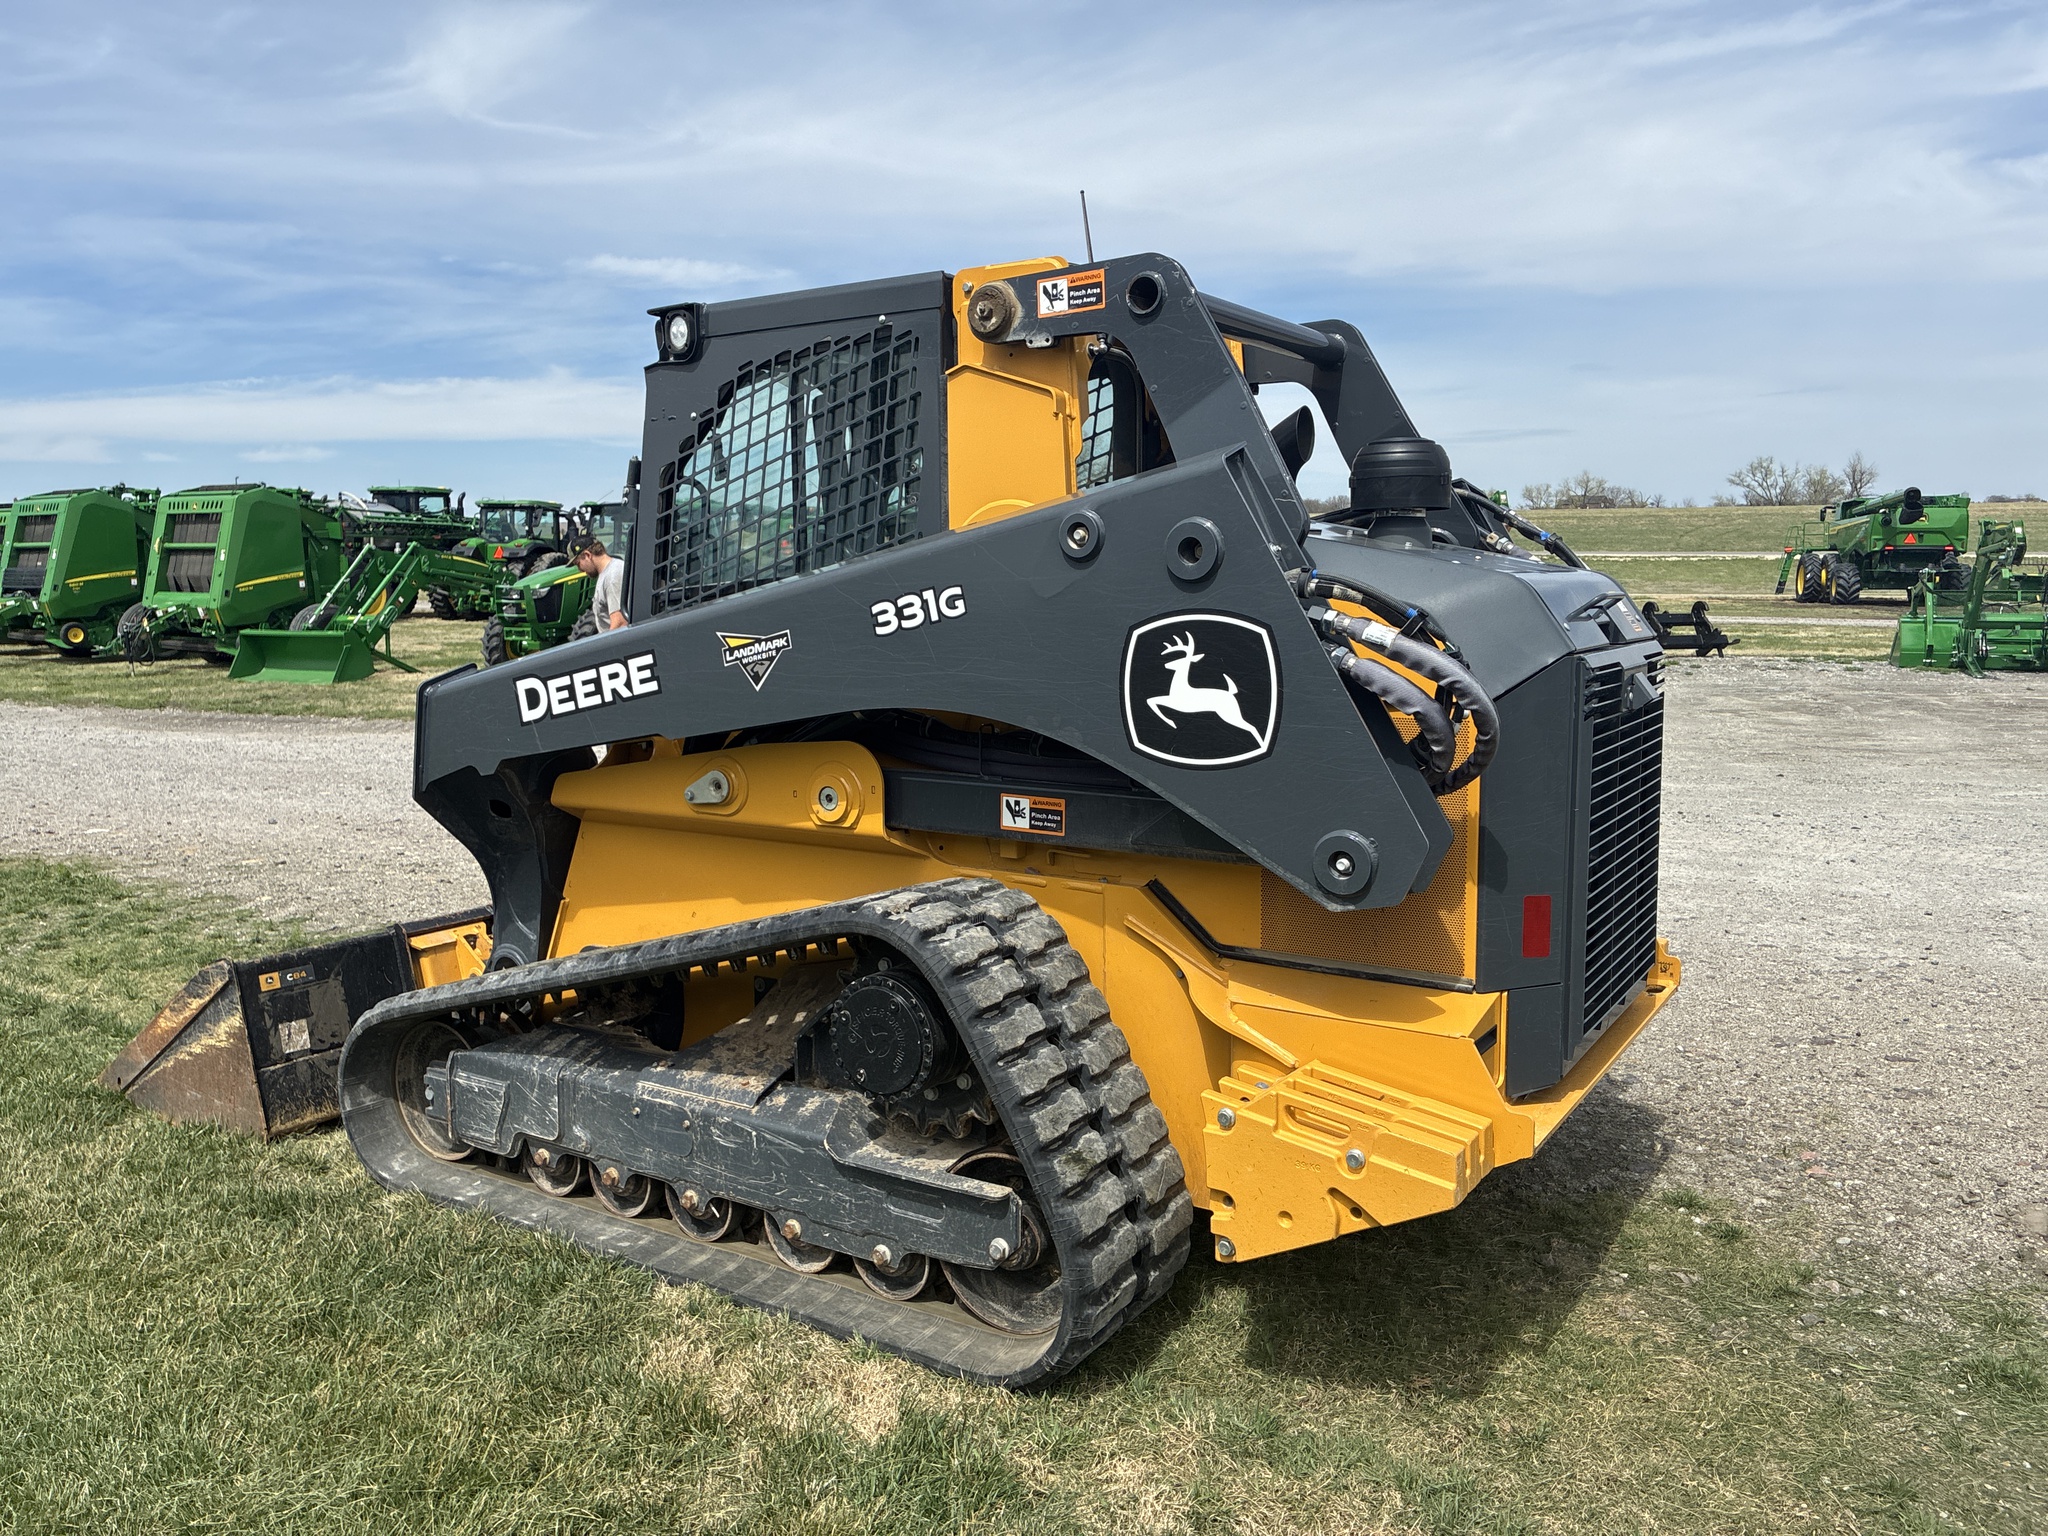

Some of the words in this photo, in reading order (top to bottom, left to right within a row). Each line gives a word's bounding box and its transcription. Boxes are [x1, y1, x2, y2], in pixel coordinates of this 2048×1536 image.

[1075, 273, 1102, 283] WARNING
[1069, 289, 1086, 298] Pinch
[1087, 287, 1101, 295] Area
[1069, 297, 1083, 305] Keep
[872, 587, 967, 636] 331G
[741, 649, 777, 665] WORKSITE
[517, 653, 659, 724] DEERE
[1036, 800, 1062, 808] WARNING
[1031, 811, 1047, 820] Pinch
[1047, 813, 1061, 821] Area
[1043, 821, 1057, 829] Away
